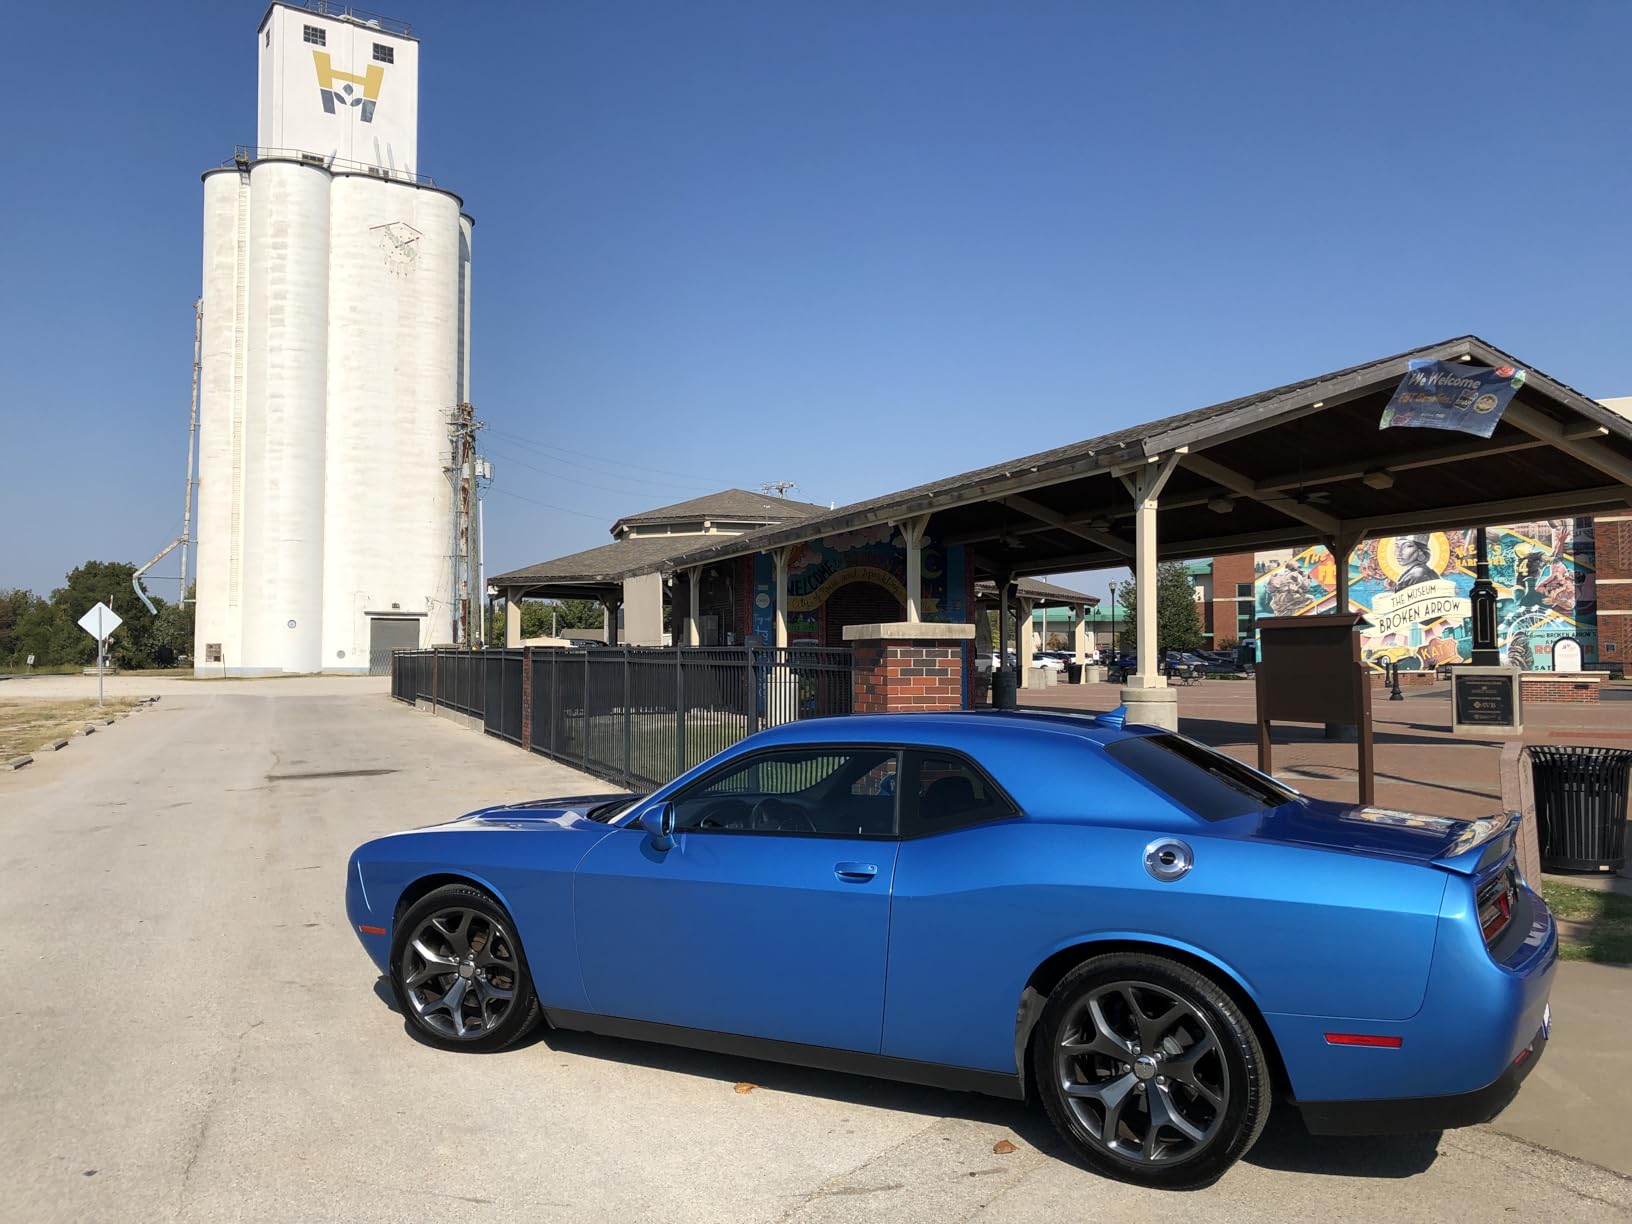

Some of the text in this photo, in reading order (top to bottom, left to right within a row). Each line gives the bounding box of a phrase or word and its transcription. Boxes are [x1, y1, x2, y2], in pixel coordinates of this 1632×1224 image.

[1409, 372, 1481, 389] We Welcome
[1391, 584, 1436, 607] THE MUSEUM
[1379, 600, 1460, 633] BROKEN ARROW
